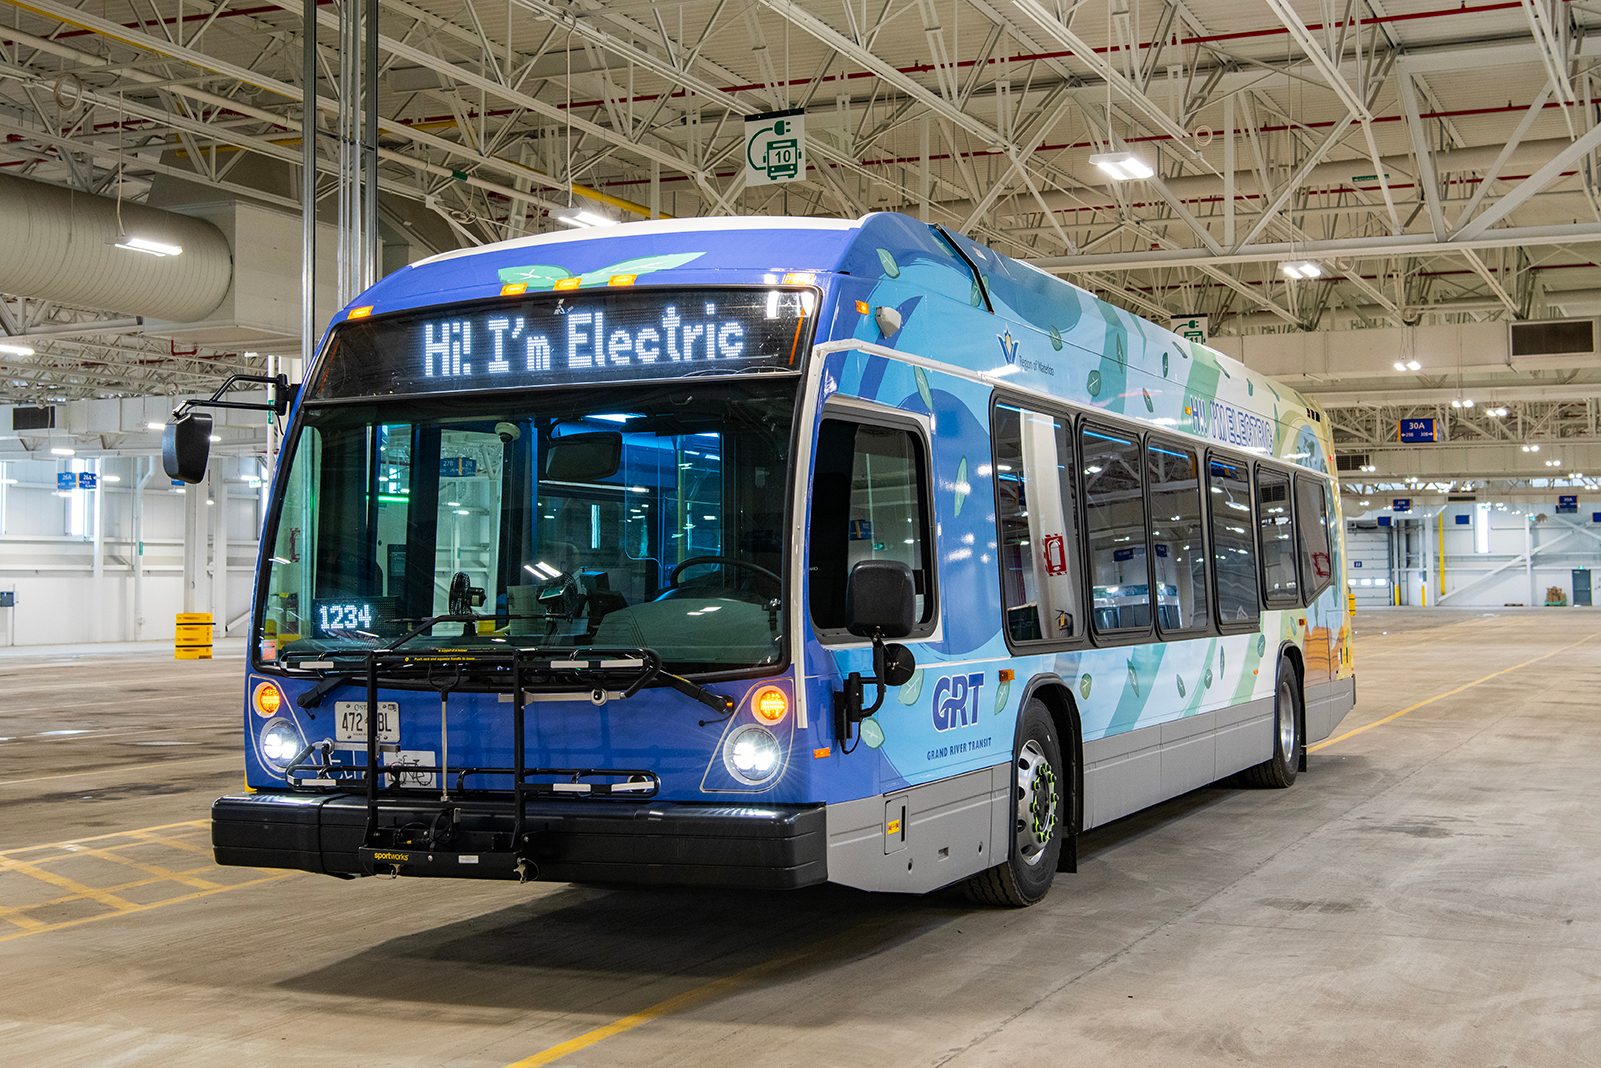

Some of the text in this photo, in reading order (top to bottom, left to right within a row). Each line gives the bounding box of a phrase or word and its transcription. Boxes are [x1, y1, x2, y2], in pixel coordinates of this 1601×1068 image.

[775, 150, 791, 163] 10
[425, 302, 743, 377] Hi! I'm Electric
[1409, 422, 1426, 430] 30A
[320, 604, 371, 629] 1234
[932, 671, 985, 733] GRT
[342, 712, 392, 732] 472 BL
[927, 737, 992, 760] GRAND RIVER TRANSIT
[374, 852, 409, 861] sportworks
